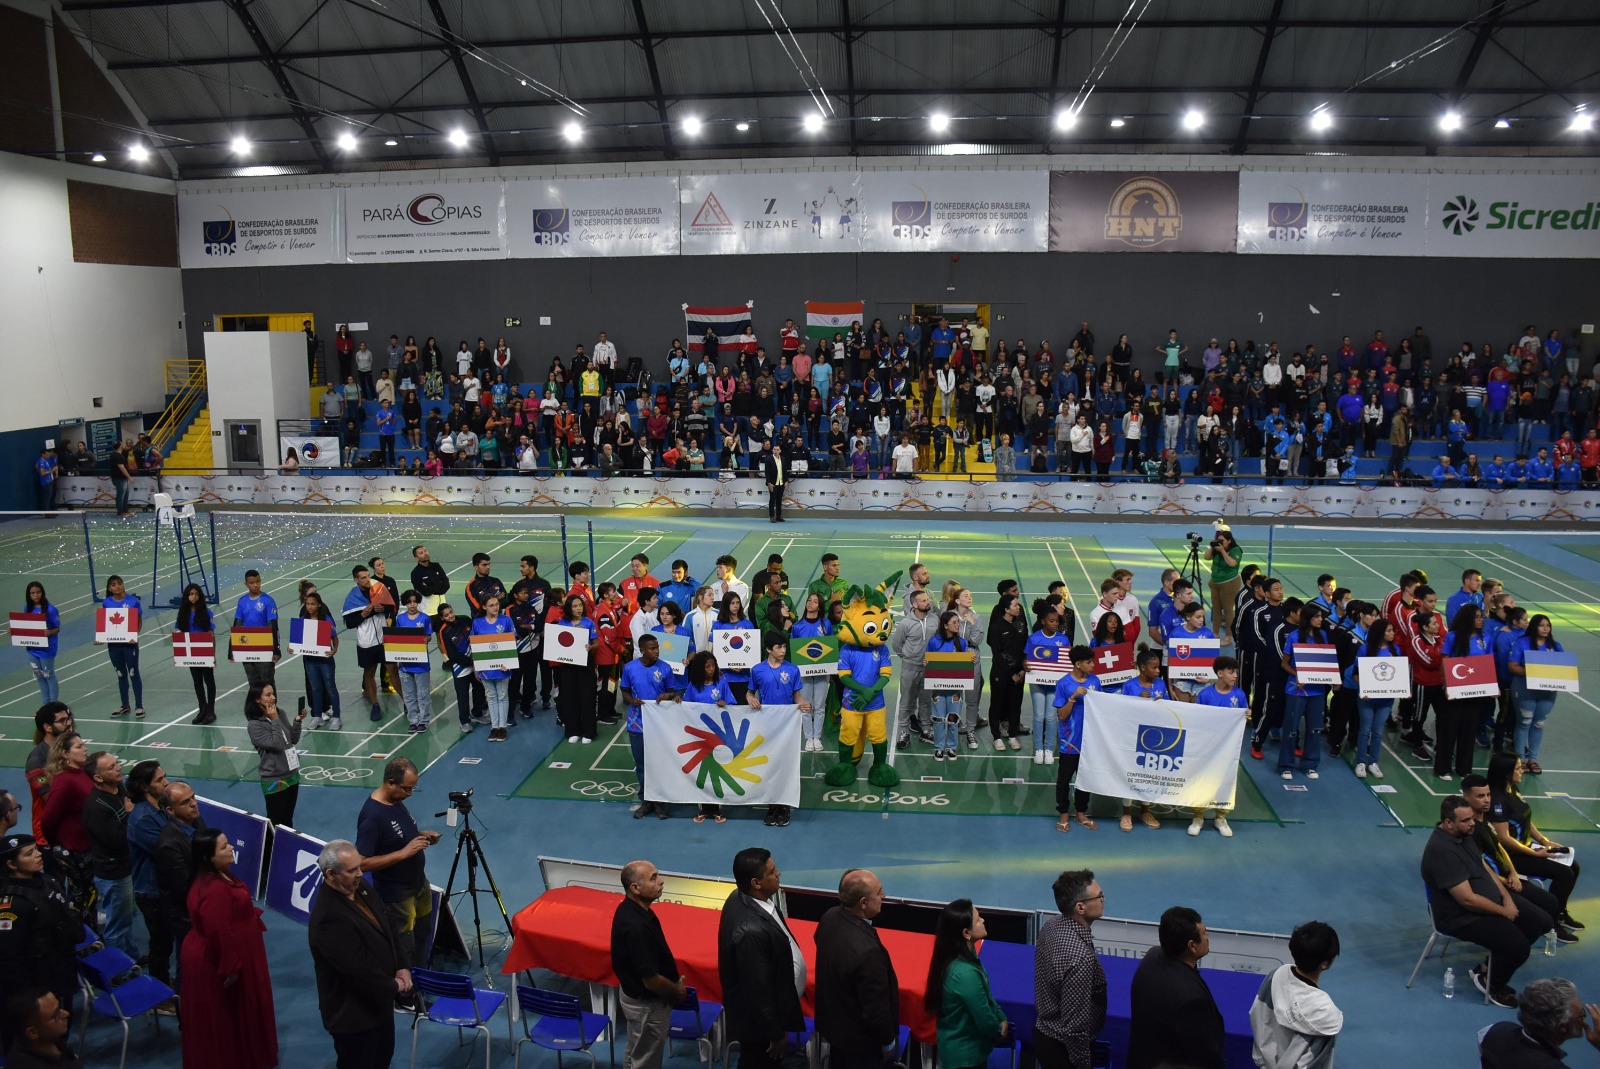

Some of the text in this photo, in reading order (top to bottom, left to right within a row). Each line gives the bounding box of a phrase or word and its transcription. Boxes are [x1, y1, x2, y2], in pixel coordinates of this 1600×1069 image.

[363, 204, 404, 221] PARÁ
[572, 208, 623, 217] CONFEDERAÇÃO
[934, 202, 989, 211] CONFEDERAÇÃO
[1311, 204, 1366, 213] CONFEDERAÇÃO
[1486, 202, 1600, 230] Sicredi
[238, 219, 283, 228] CONFEDERAÇÃO
[744, 219, 798, 229] ZINZANE
[941, 223, 980, 238] Competir
[994, 223, 1025, 235] Vencer
[1108, 218, 1179, 236] HNT
[534, 232, 570, 246] CBDS
[579, 229, 615, 242] Competir
[629, 228, 658, 239] Vencer
[891, 225, 931, 240] CBDS
[1268, 226, 1308, 242] CBDS
[1317, 225, 1358, 242] Competir
[1371, 226, 1402, 238] Vencer
[204, 243, 237, 256] CBDS
[245, 239, 277, 254] Competir
[289, 238, 315, 249] Vencer
[164, 511, 170, 522] 4
[1100, 676, 1132, 684] ITZERLAND
[1136, 751, 1184, 771] CBDS
[1127, 772, 1160, 781] CONFEDERAÇÃO
